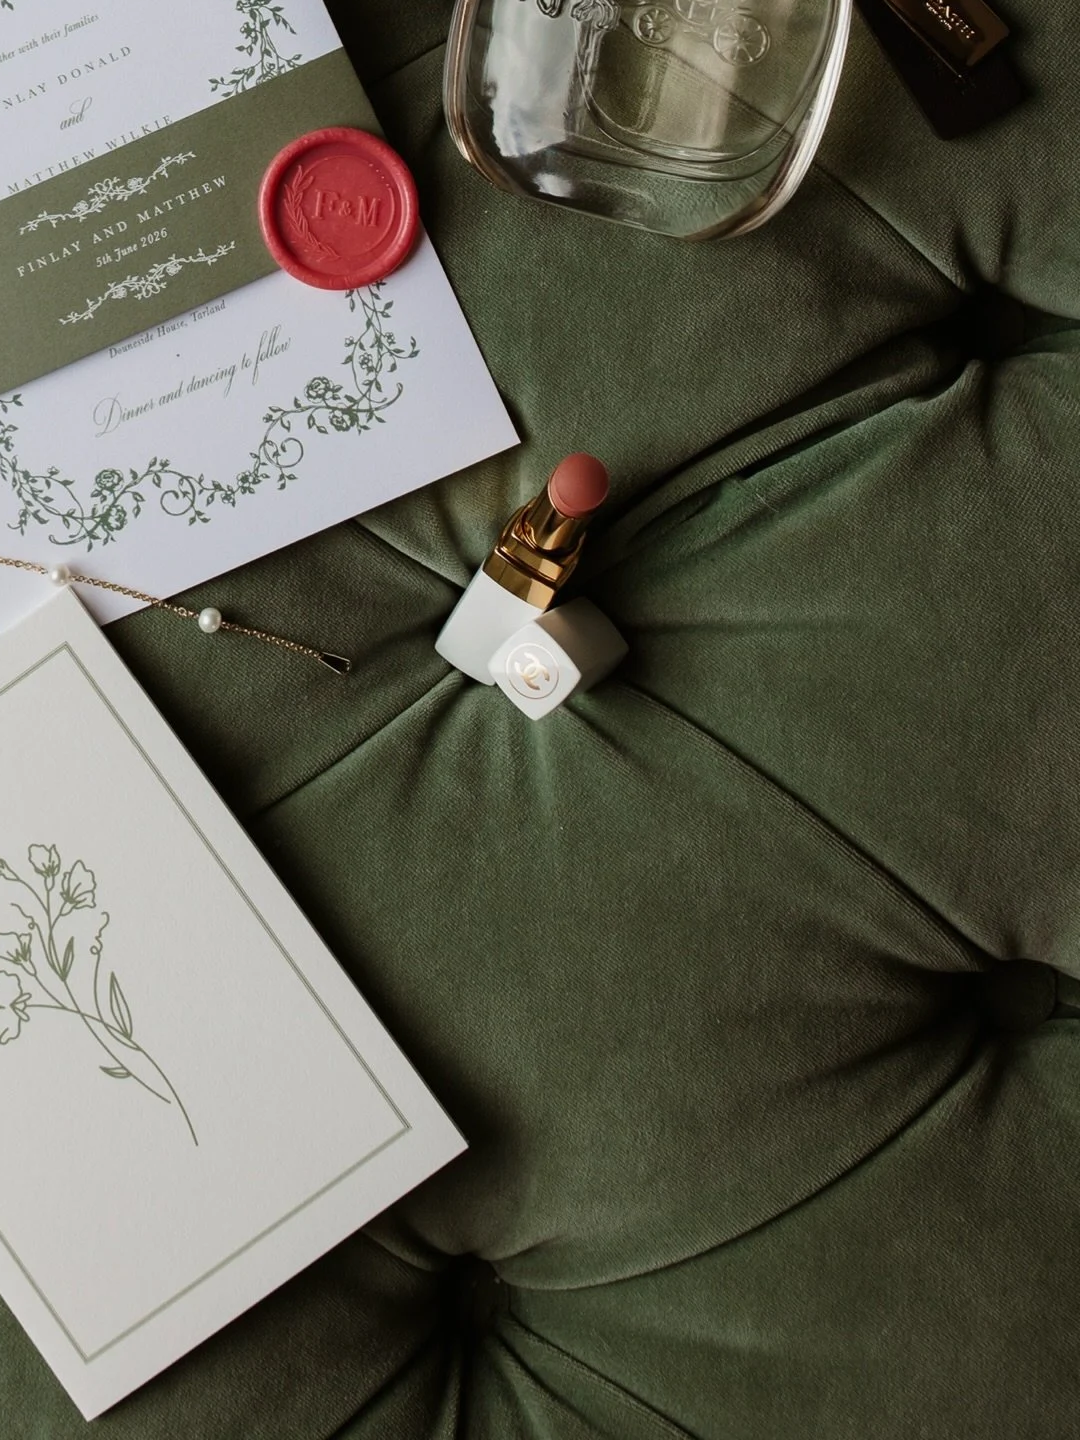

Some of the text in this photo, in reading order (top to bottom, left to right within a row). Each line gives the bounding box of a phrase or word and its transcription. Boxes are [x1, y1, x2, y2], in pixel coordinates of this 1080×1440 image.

[18, 38, 39, 54] with
[41, 29, 61, 45] their
[63, 13, 100, 38] families
[57, 46, 131, 85] DONALD
[59, 96, 93, 130] and
[7, 114, 173, 194] MATTHEW WILKIE
[17, 175, 228, 278] FINLAY AND MATTHEW
[95, 227, 168, 268] 5th June 2026
[108, 332, 154, 359] Douneside
[191, 299, 226, 323] Tarland
[92, 324, 292, 438] Dinner and dancing to follow
